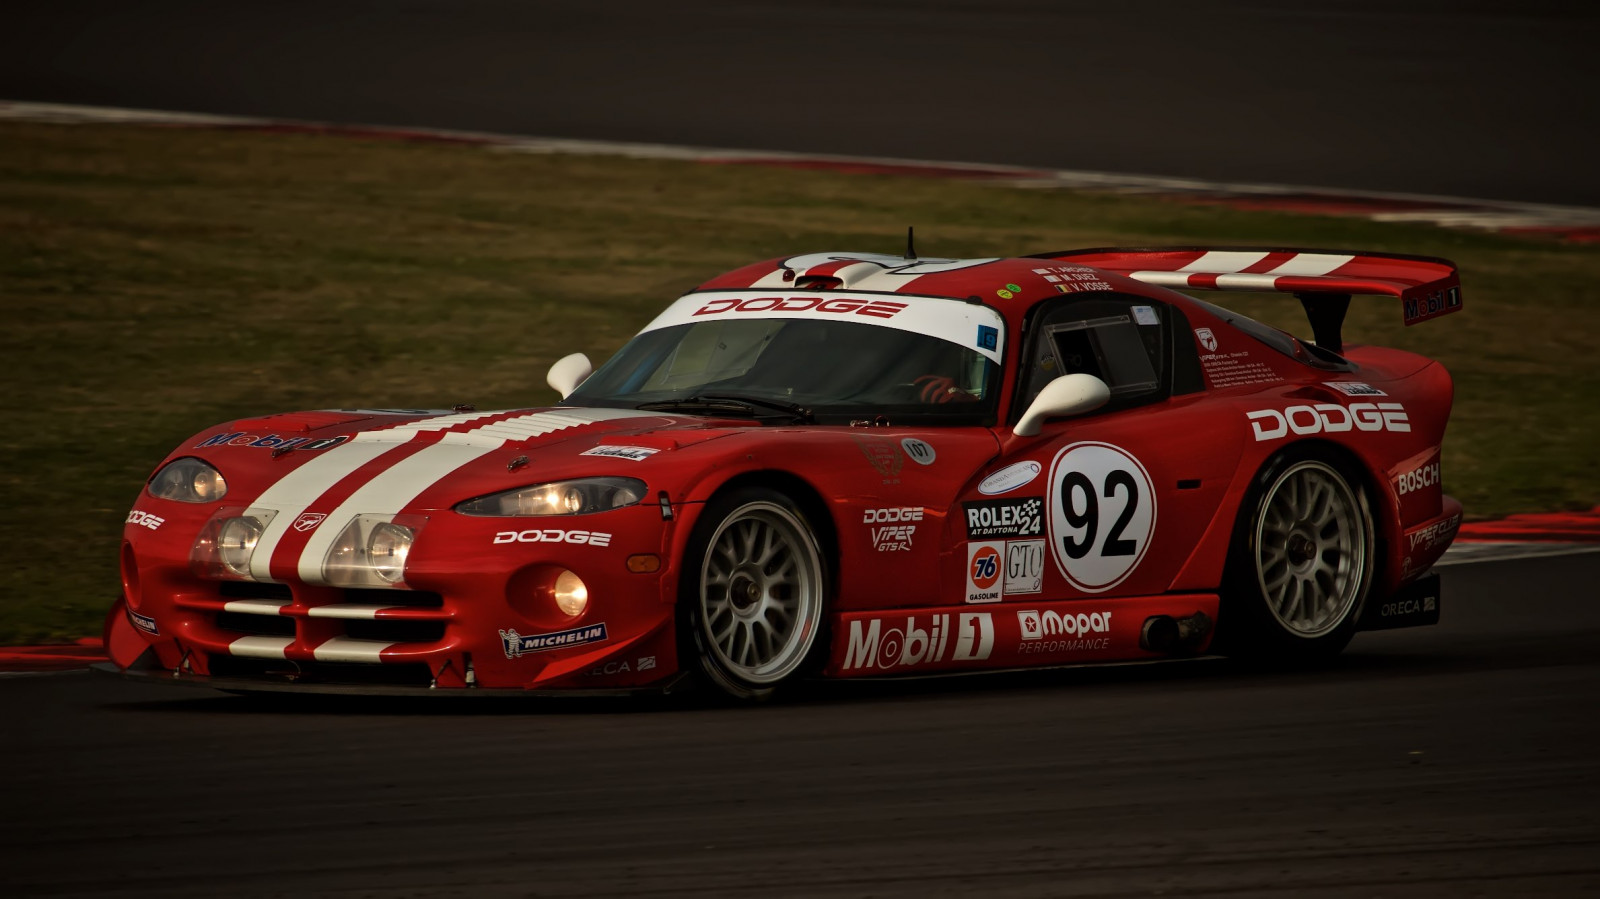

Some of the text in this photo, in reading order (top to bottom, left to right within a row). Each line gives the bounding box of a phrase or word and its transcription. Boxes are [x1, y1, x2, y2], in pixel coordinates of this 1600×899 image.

[1071, 273, 1100, 281] DUEZ
[1079, 281, 1114, 291] VOSSE
[692, 297, 909, 318] DODGE
[1405, 289, 1445, 320] Mobil
[1246, 402, 1412, 442] DODGE
[193, 431, 312, 449] Mobil
[906, 443, 930, 458] 107
[1399, 462, 1440, 495] BOSCH
[863, 506, 924, 524] DODGE
[968, 505, 1023, 528] ROLEX
[1061, 469, 1139, 560] 92
[971, 526, 1019, 536] AT DAYTONA
[1018, 515, 1041, 535] 24
[493, 529, 612, 547] DODGE
[974, 554, 997, 580] 76
[1009, 544, 1043, 579] GTO
[969, 592, 999, 601] GASOLINE
[1381, 599, 1421, 617] ORECA
[1041, 609, 1112, 638] Mopar
[524, 627, 602, 649] MICHELIN
[842, 613, 950, 670] Mobil
[1017, 637, 1111, 654] PERFORMANCE
